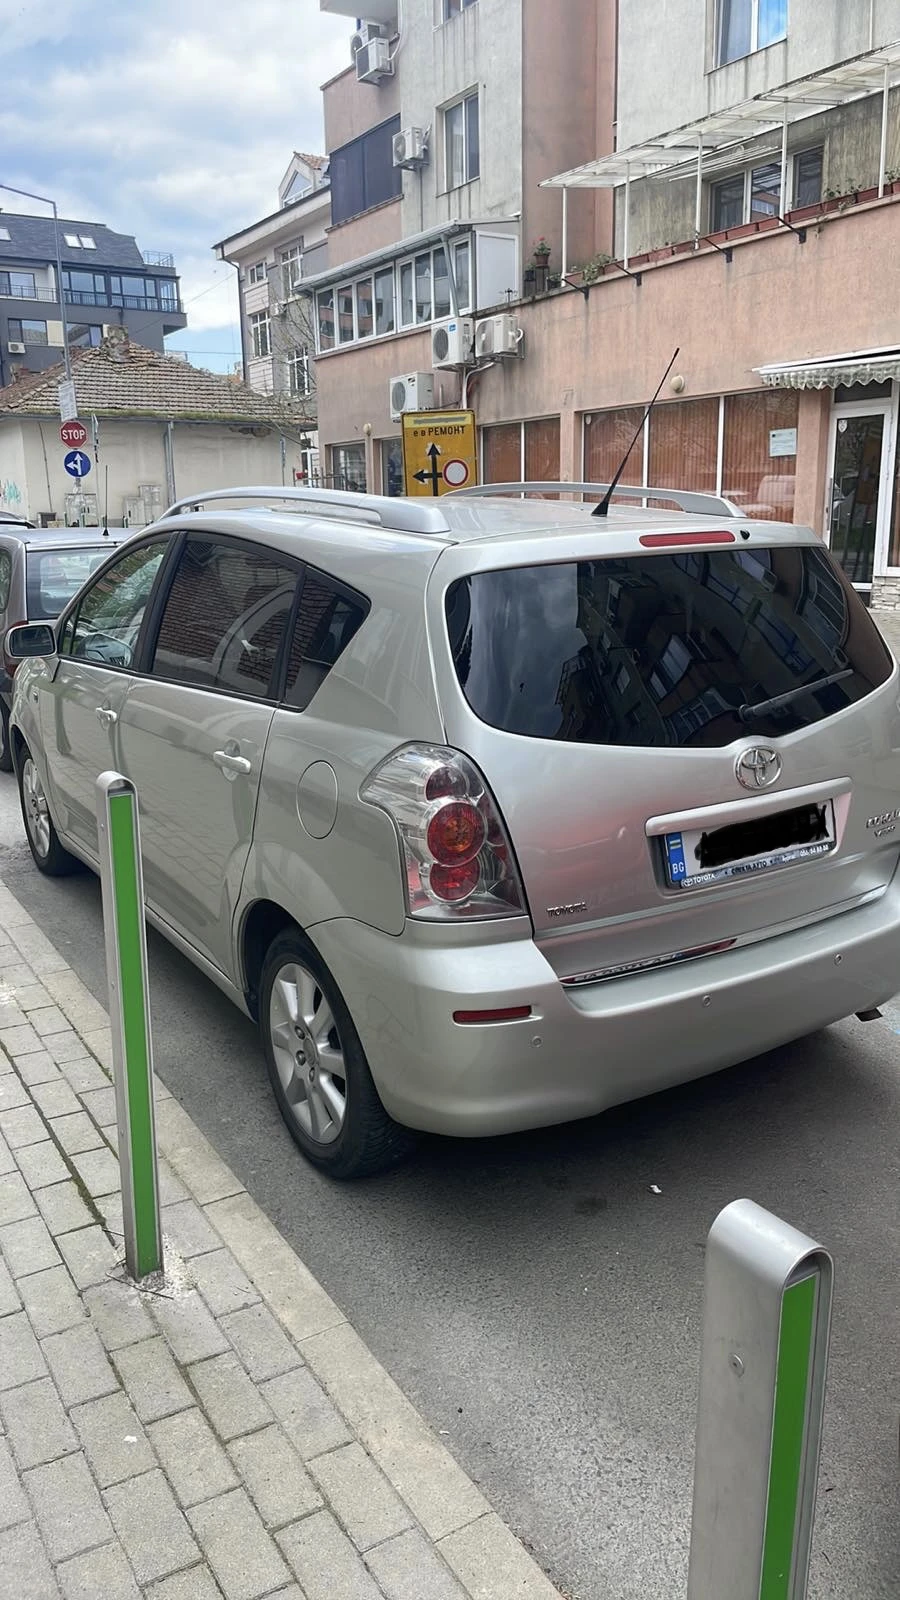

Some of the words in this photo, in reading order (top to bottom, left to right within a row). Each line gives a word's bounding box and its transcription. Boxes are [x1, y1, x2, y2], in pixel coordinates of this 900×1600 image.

[62, 429, 86, 440] STOP
[428, 425, 466, 437] РЕМОНТ
[672, 861, 685, 874] BG
[693, 873, 716, 884] TOYOTA
